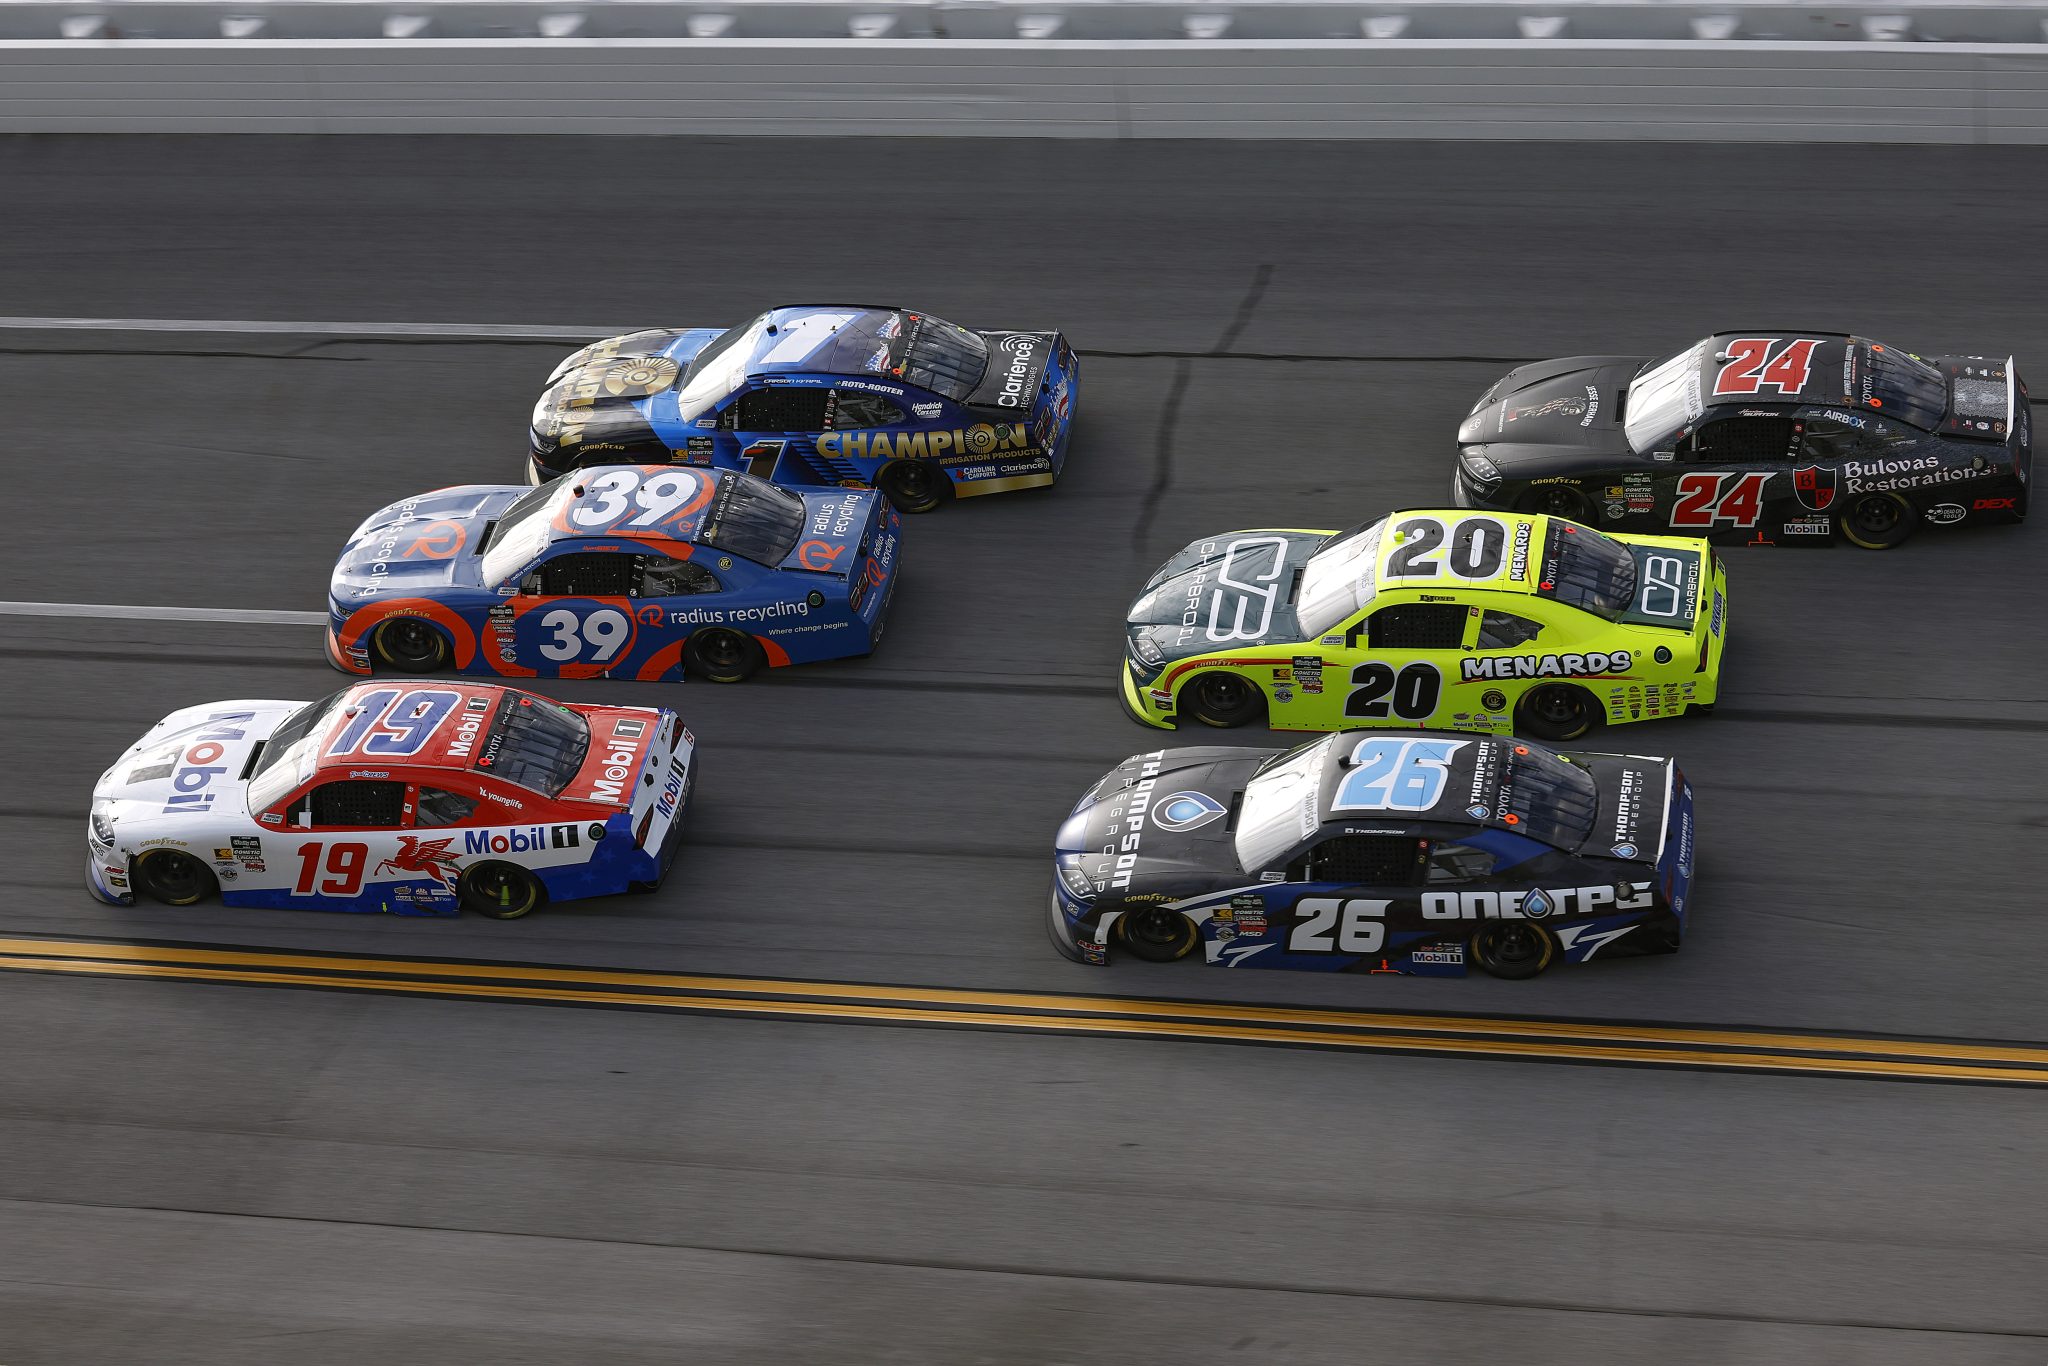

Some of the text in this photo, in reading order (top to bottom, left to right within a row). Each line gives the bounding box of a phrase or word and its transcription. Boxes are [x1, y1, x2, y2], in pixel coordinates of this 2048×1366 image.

[758, 314, 857, 364] 1
[998, 340, 1034, 408] Clarience
[1712, 338, 1827, 397] 24
[840, 380, 904, 396] ROTO-ROOTER
[1020, 366, 1038, 409] TECHNOLOGIES
[1688, 380, 1698, 412] BURTON
[1862, 375, 1873, 404] TOYOTA
[911, 402, 943, 412] Hendrick
[916, 408, 942, 418] Cars.com
[1823, 409, 1867, 430] AIRBOX
[579, 441, 626, 451] GOODYEAR
[816, 423, 1028, 460] CHAMPION
[992, 448, 1041, 460] PRODUCTS
[740, 440, 786, 481] 1
[939, 453, 991, 465] IRRIGATION
[963, 465, 996, 476] CAROLINA
[1000, 462, 1044, 473] Clarience
[1843, 456, 1939, 479] Bulovas
[967, 471, 997, 481] CARPORTS
[1530, 476, 1582, 485] GOODYEAR
[1800, 474, 1812, 486] B
[1846, 466, 1991, 494] Restorations
[572, 470, 697, 526] 39
[1668, 472, 1779, 528] 24
[1973, 498, 2017, 510] DEX
[813, 504, 835, 535] radius
[832, 494, 863, 537] recycling
[1785, 525, 1816, 533] Mobil
[873, 534, 885, 559] radius
[881, 534, 897, 568] recycling
[1384, 517, 1508, 580] 20
[1510, 522, 1531, 582] MENARDS
[1552, 525, 1561, 557] ACING
[359, 534, 400, 597] recycling
[523, 557, 541, 573] recycling
[1175, 542, 1216, 647] CHARBROIL
[1684, 560, 1699, 620] CHARBROIL
[384, 607, 431, 619] GOODYEAR
[670, 600, 809, 624] radius recycling
[768, 621, 849, 636] Where change begins
[539, 609, 629, 661] 39
[1194, 658, 1245, 669] GOODYEAR
[1461, 650, 1633, 681] MENARDS
[1344, 660, 1441, 720] 20
[324, 689, 463, 757] 19
[501, 697, 515, 731] ACING
[447, 713, 485, 757] Mobil
[162, 711, 256, 814] Mobil
[590, 740, 639, 803] Mobil
[1330, 737, 1474, 812] 26
[1470, 739, 1490, 804] THOMPSON
[655, 771, 682, 820] Mobil
[1496, 744, 1514, 821] TOYOTA ACING
[488, 791, 523, 810] younglife
[672, 777, 691, 831] TOYOTA
[1615, 769, 1634, 842] THOMPSON
[1111, 749, 1166, 888] THOMPSON
[140, 837, 188, 848] GOODYEAR
[464, 827, 546, 855] Mobil
[1679, 812, 1689, 863] THOMPSON
[294, 842, 369, 896] 19
[1124, 893, 1179, 904] GOODYEAR
[1288, 897, 1395, 953] 26
[1414, 953, 1448, 962] Mobil
